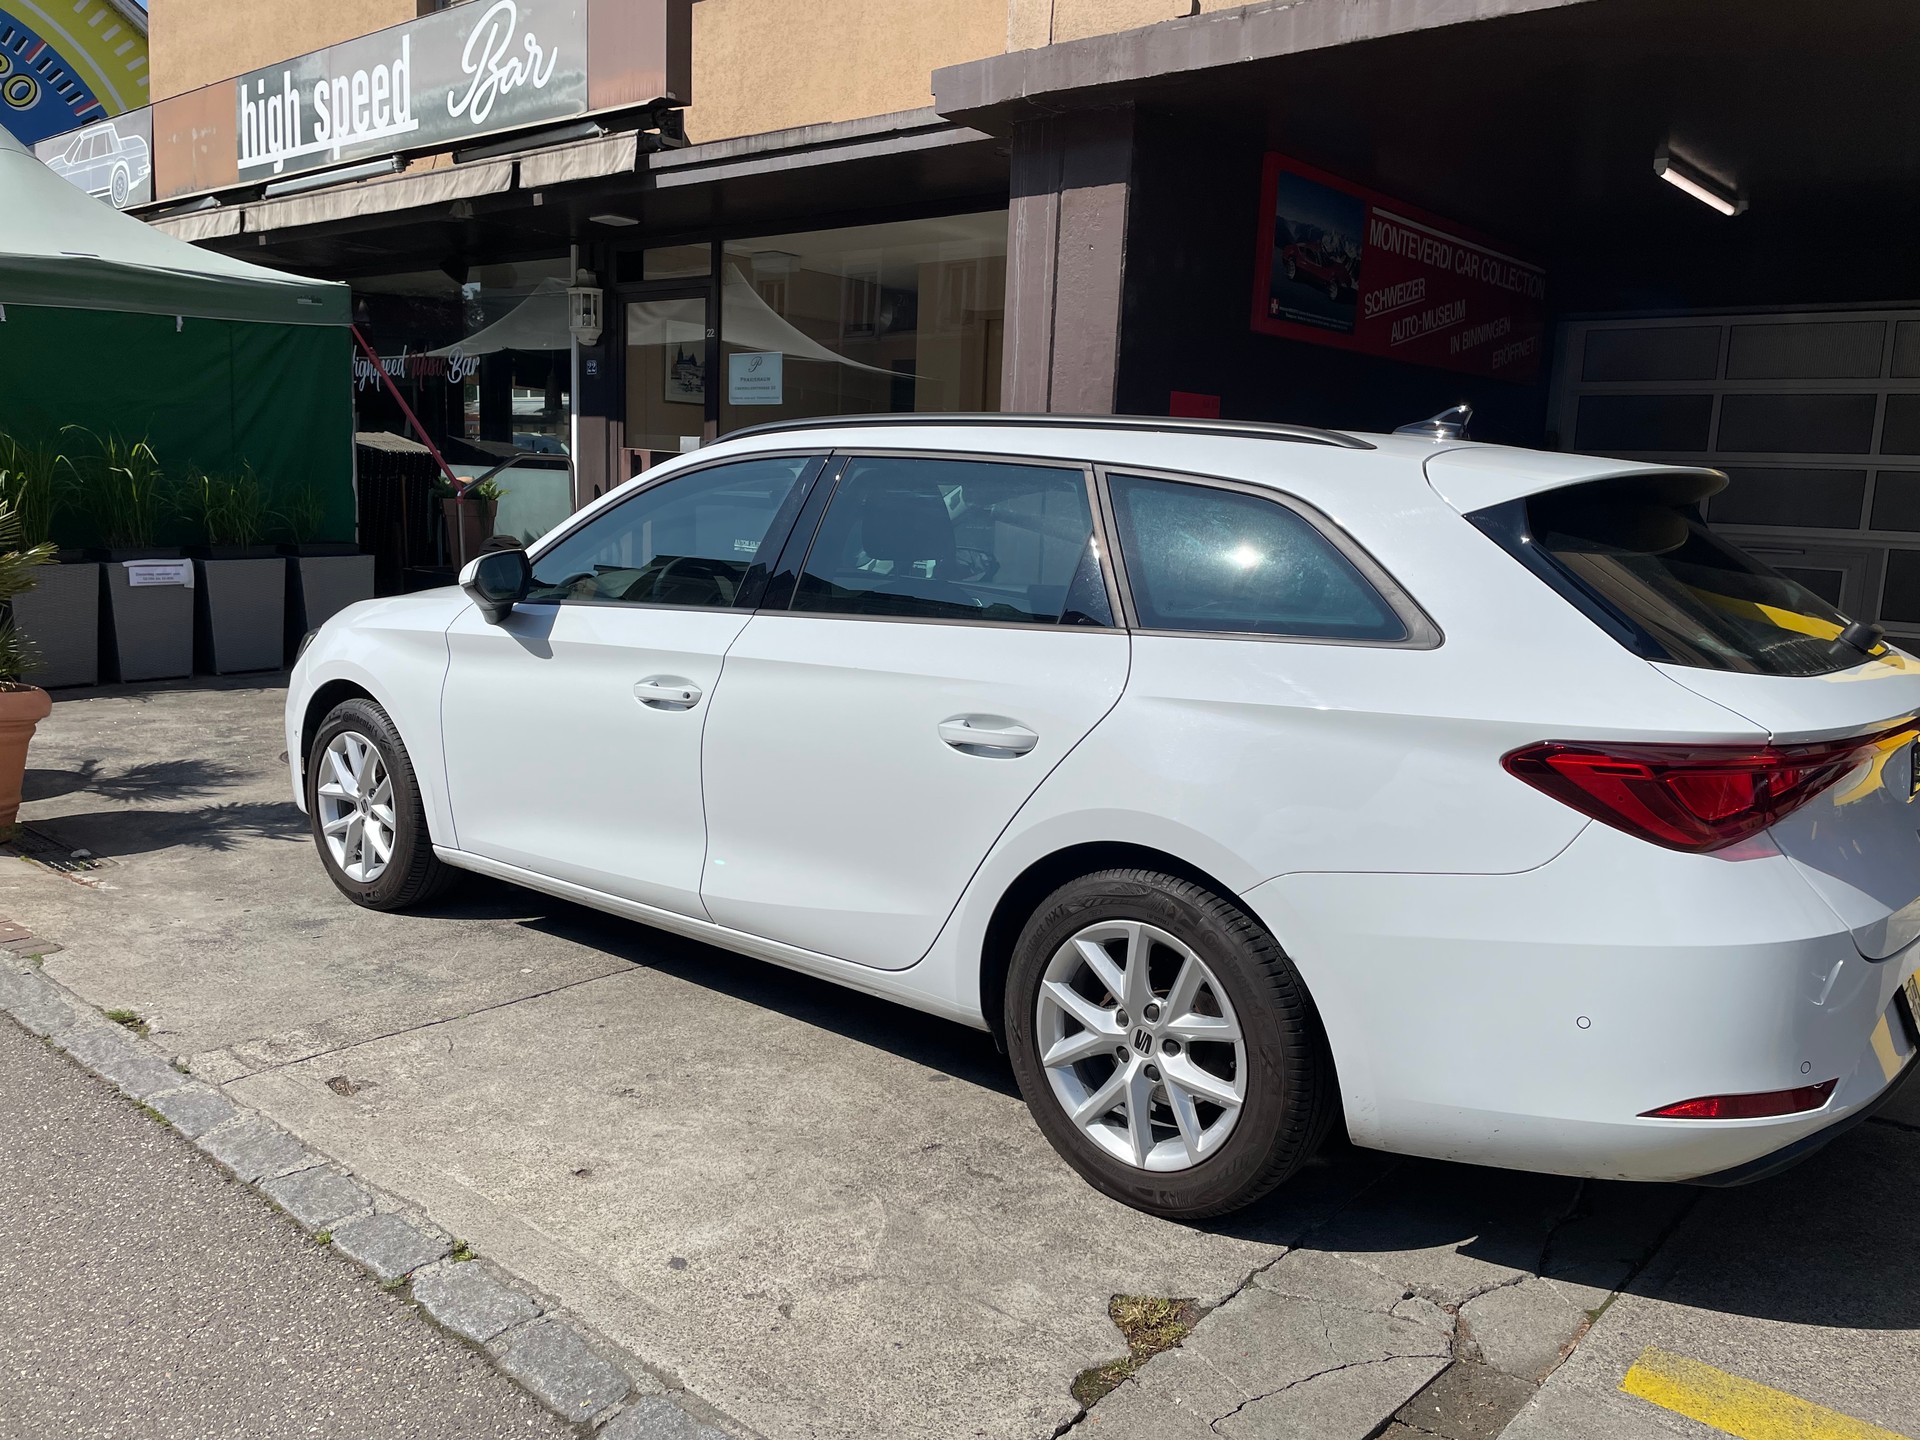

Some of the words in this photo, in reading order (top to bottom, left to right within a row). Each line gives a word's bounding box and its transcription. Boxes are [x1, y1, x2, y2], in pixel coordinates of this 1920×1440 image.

[240, 70, 301, 174] high
[313, 33, 418, 161] speed
[447, 0, 558, 125] Bar
[1369, 219, 1453, 270] MONTEVERDI
[1455, 249, 1479, 279] CAR
[1480, 259, 1547, 301] COLLECTION
[1364, 277, 1426, 315] SCHWEIZER
[706, 328, 715, 338] 22
[1390, 299, 1466, 343] AUTO-MUSEUM
[1450, 333, 1460, 355] IN
[1462, 315, 1511, 351] BINNINGEN
[447, 346, 480, 384] Bar
[1044, 903, 1065, 928] NXT
